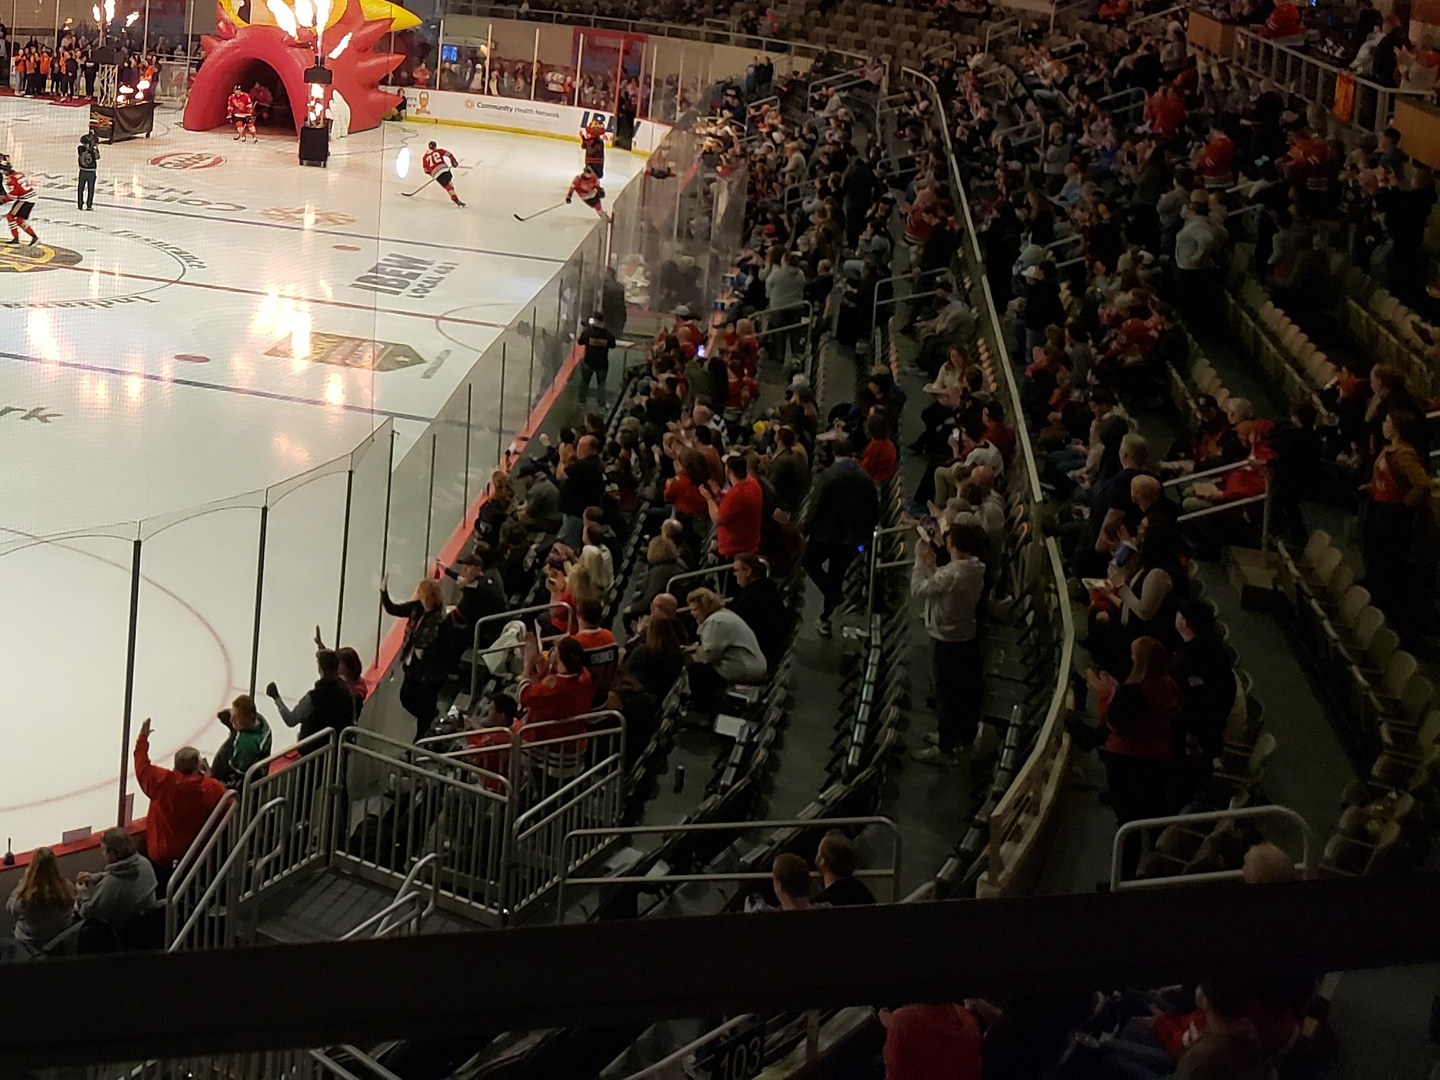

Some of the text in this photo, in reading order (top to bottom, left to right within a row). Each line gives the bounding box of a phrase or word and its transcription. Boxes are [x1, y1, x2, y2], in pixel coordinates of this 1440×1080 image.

[476, 101, 514, 113] Community
[425, 151, 442, 167] 72
[348, 252, 437, 296] IBEW
[406, 275, 447, 299] LOCAL
